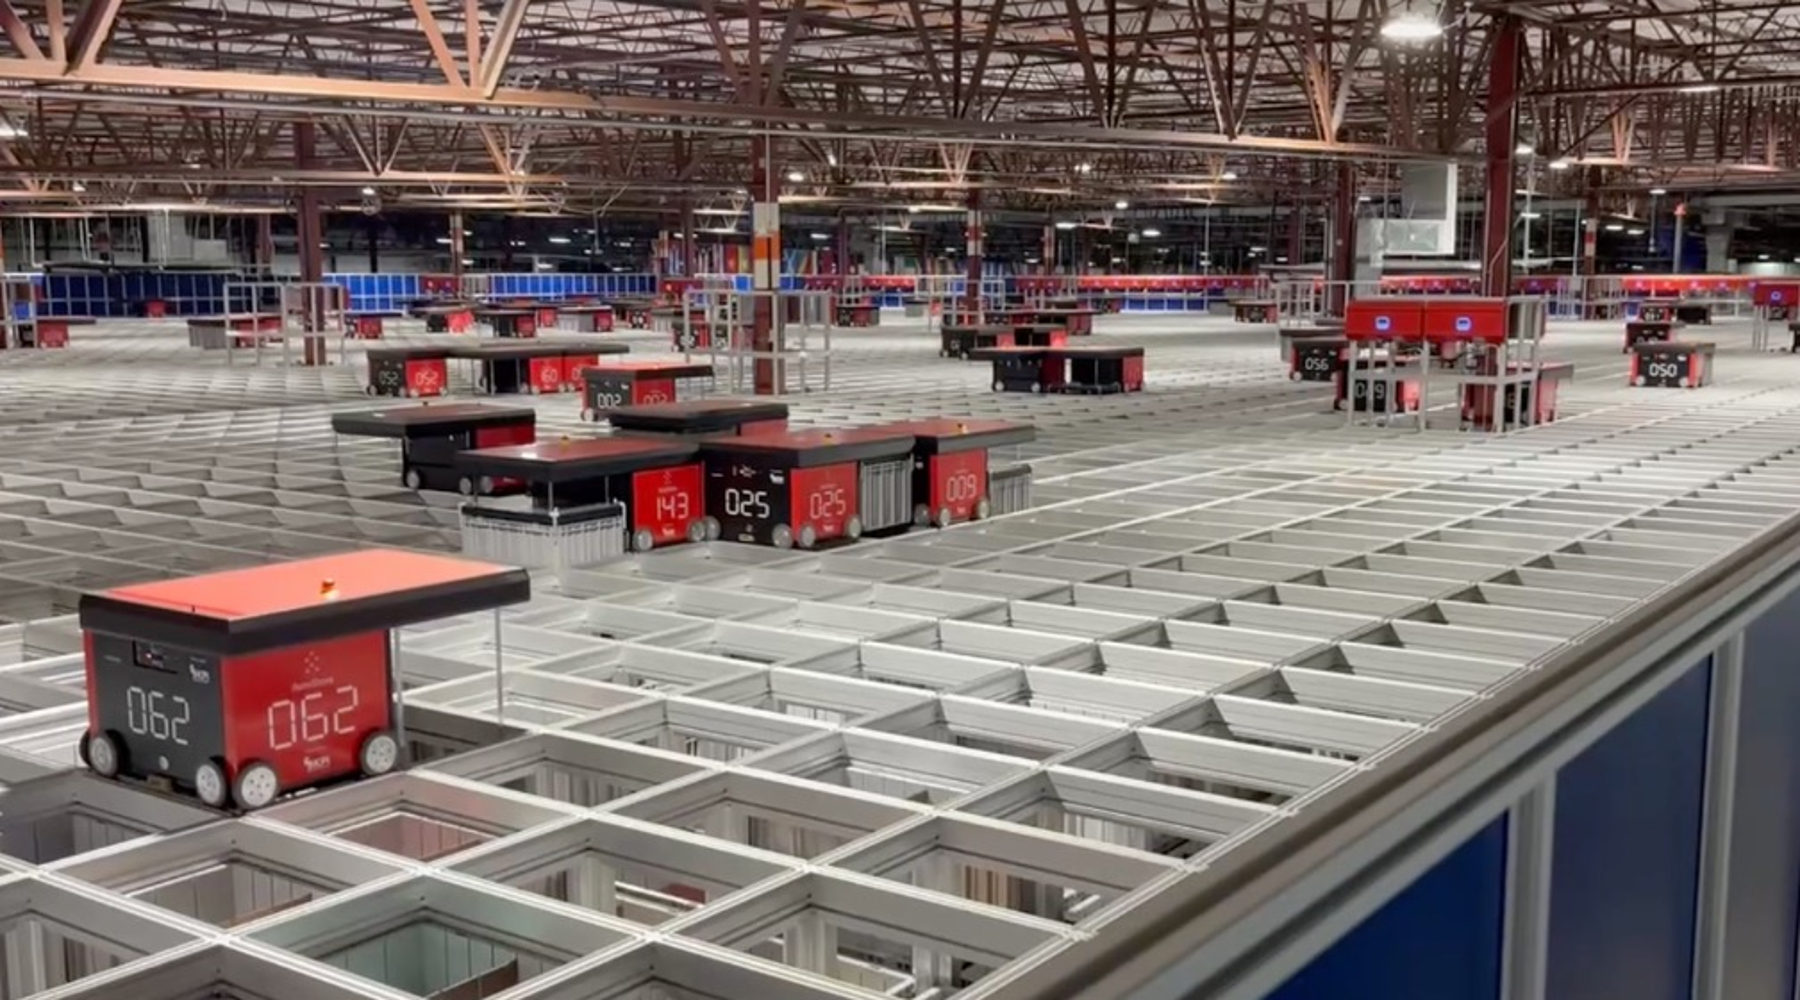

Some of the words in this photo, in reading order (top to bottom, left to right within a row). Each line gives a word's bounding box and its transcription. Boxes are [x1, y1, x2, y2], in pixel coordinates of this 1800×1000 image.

[415, 371, 439, 386] 052
[1304, 357, 1329, 371] 056
[1649, 363, 1678, 378] 050
[597, 392, 622, 409] 002
[946, 473, 977, 502] 009
[656, 492, 690, 521] 143
[724, 488, 771, 519] 025
[810, 488, 847, 519] 025
[126, 685, 190, 746] 062
[267, 684, 359, 751] 062
